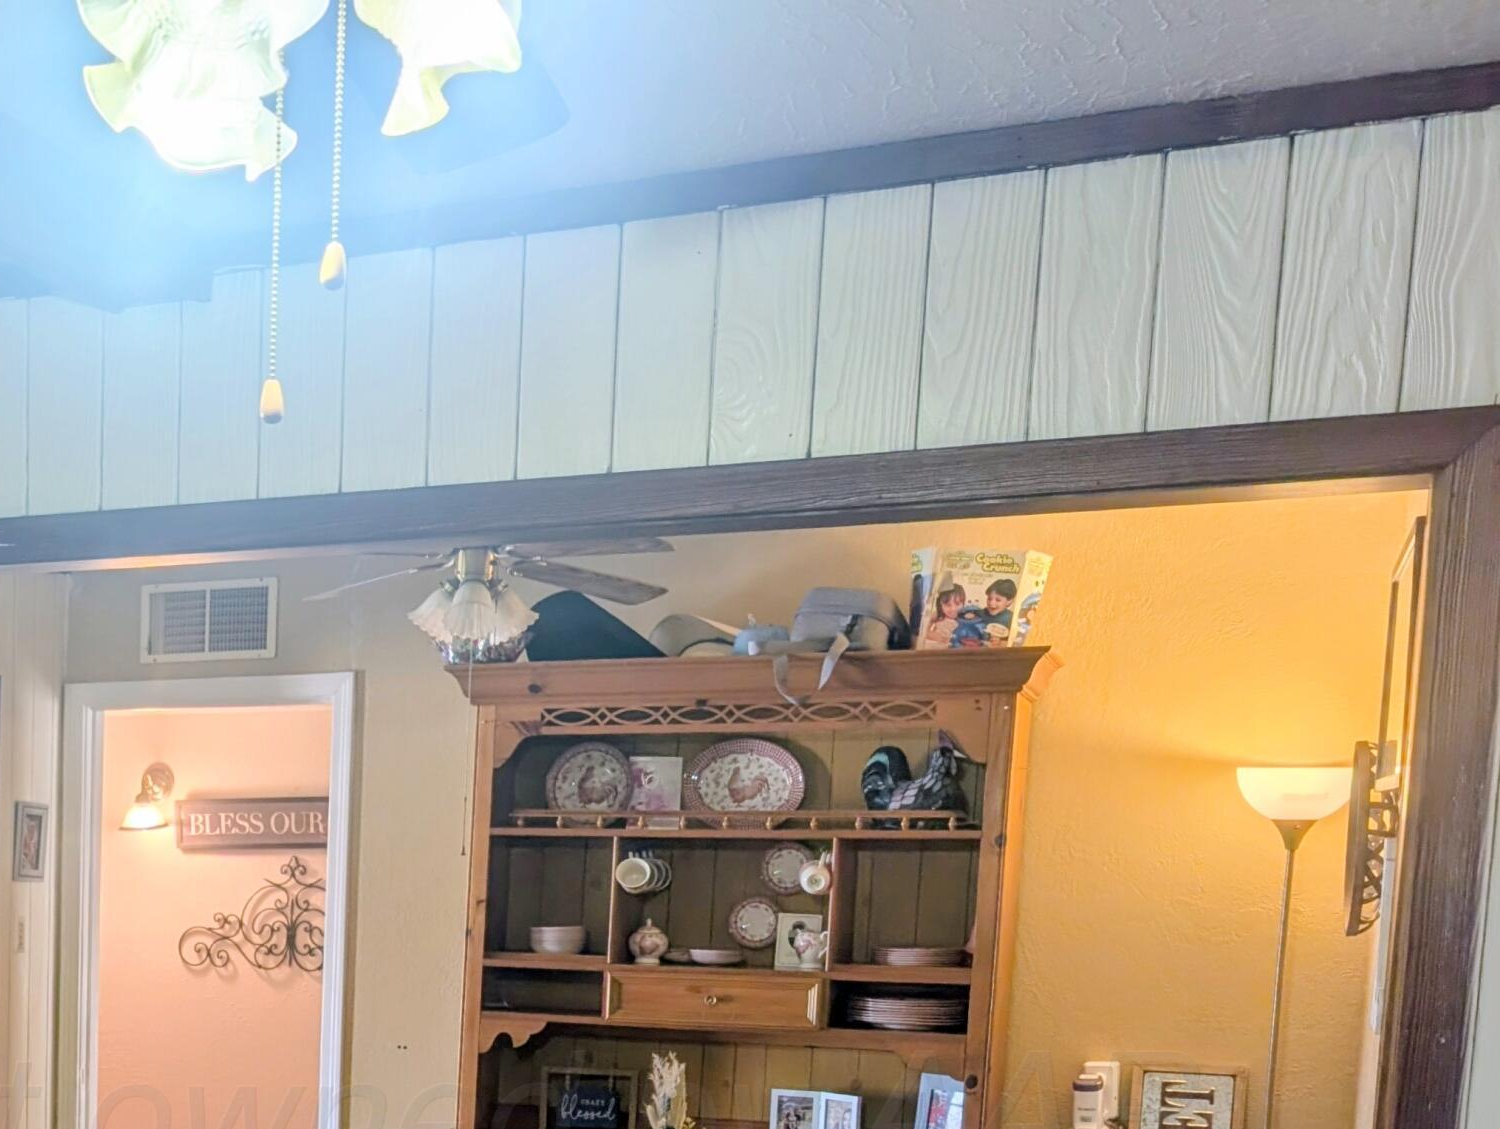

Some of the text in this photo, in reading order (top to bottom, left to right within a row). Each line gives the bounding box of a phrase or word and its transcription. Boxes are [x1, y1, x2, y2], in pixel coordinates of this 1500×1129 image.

[974, 552, 1014, 566] Cookie
[982, 562, 1021, 575] Crunch
[187, 810, 325, 836] BLESS OUR
[560, 1093, 616, 1121] blessed
